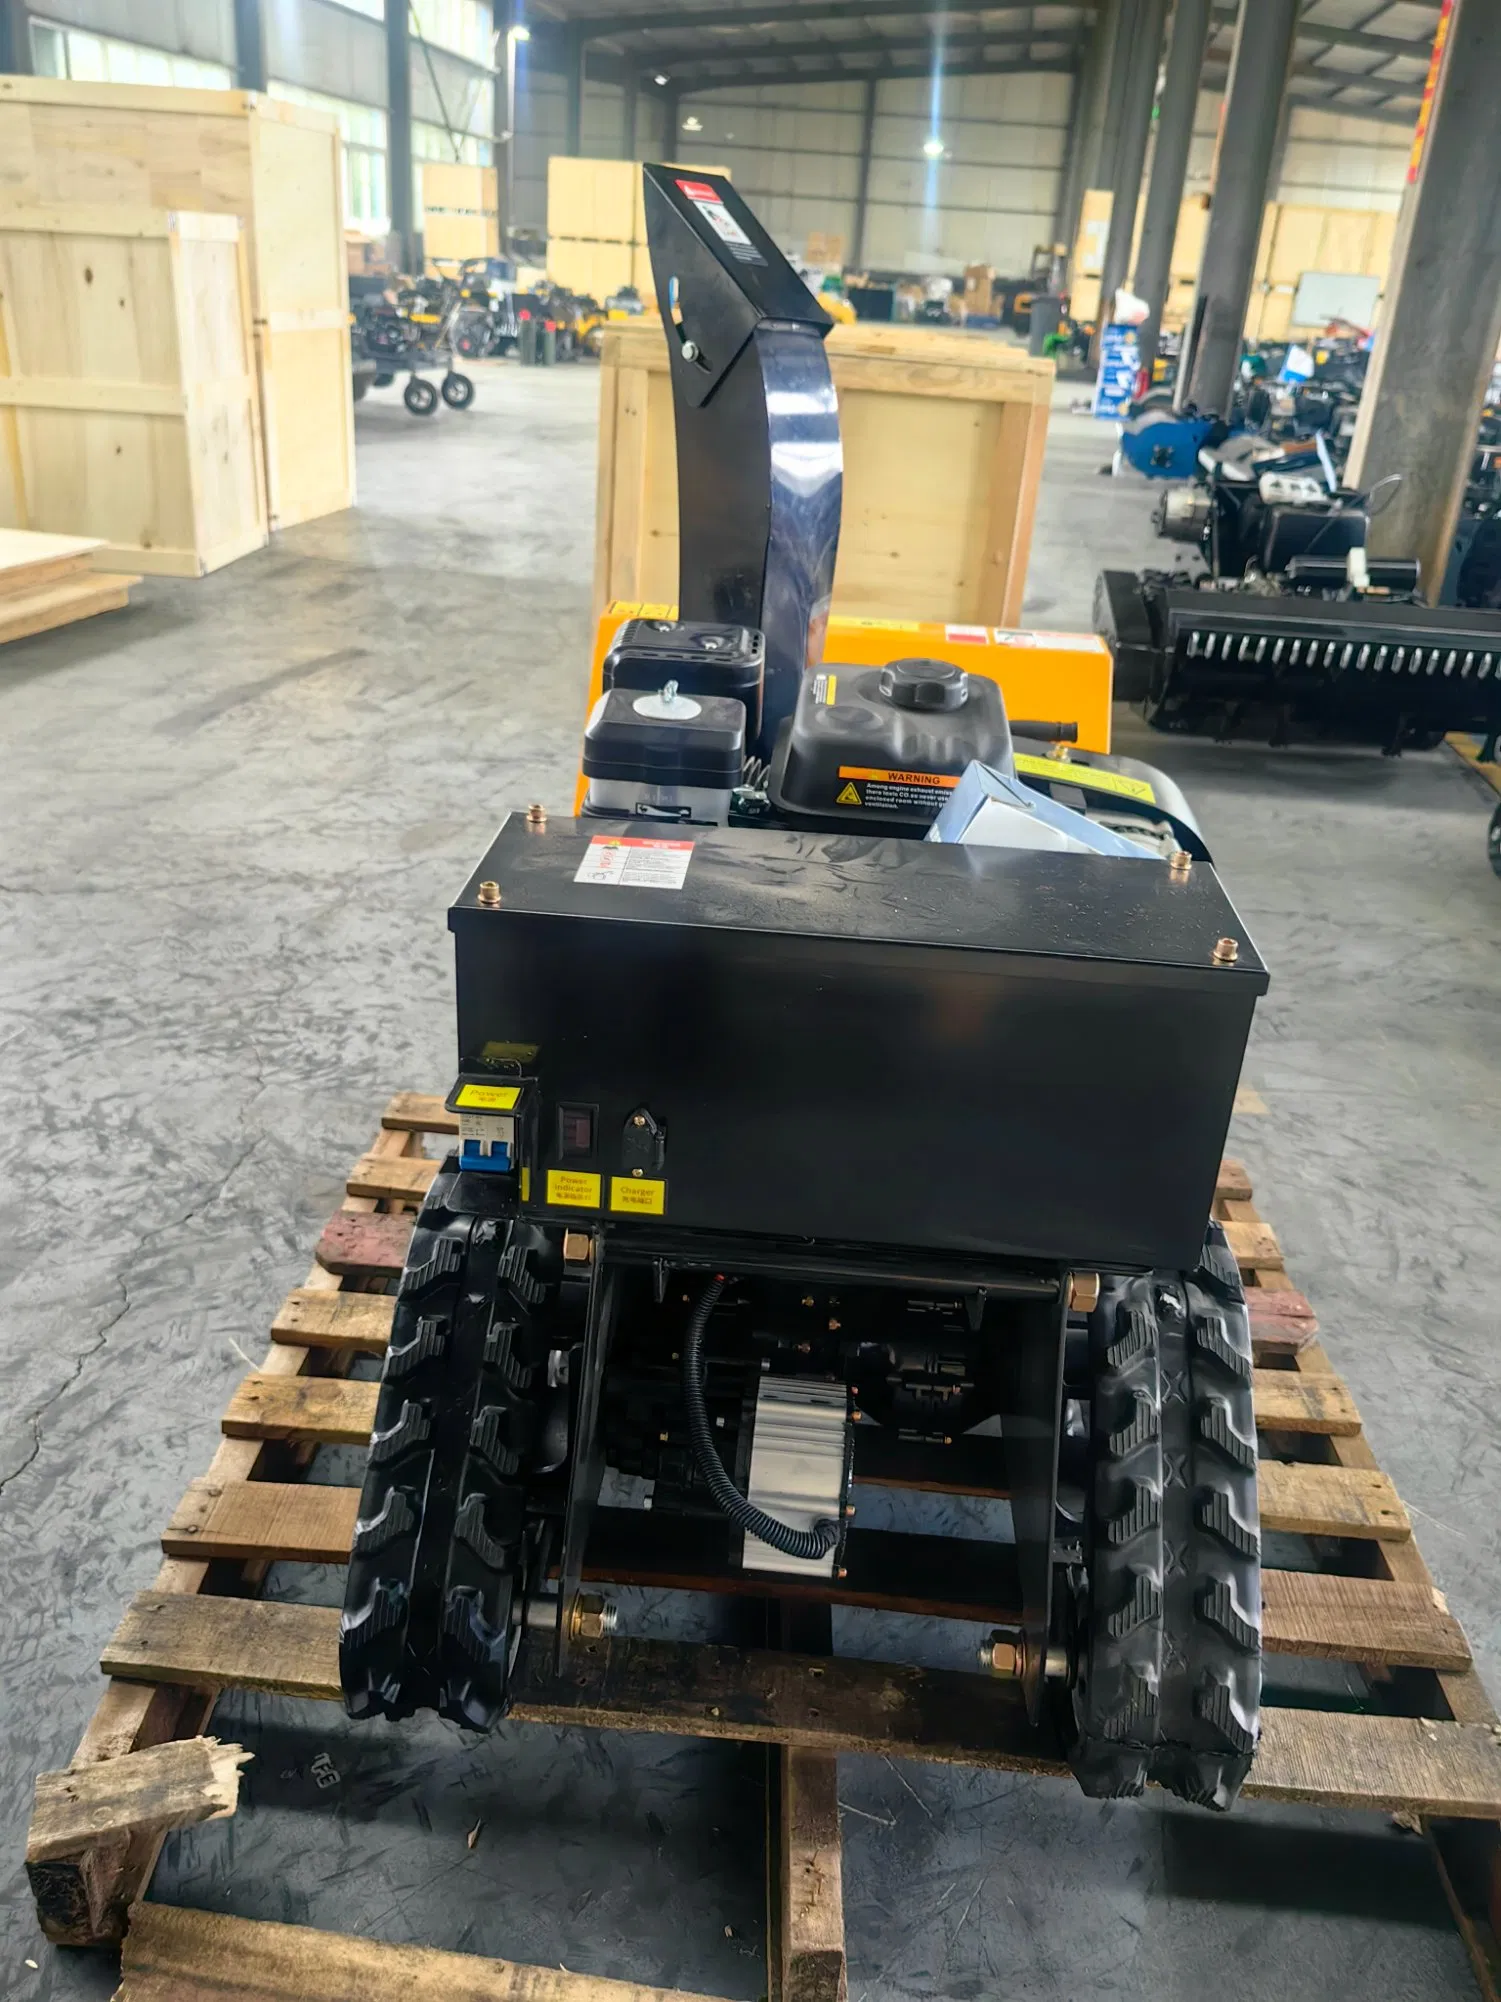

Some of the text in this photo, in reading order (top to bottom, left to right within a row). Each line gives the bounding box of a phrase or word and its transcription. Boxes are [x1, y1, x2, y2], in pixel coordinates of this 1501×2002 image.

[888, 773, 940, 784] WARNING
[867, 783, 888, 791] Among
[889, 785, 909, 793] engine
[471, 1089, 508, 1097] Power
[560, 1176, 587, 1184] Power
[620, 1186, 655, 1197] Charger
